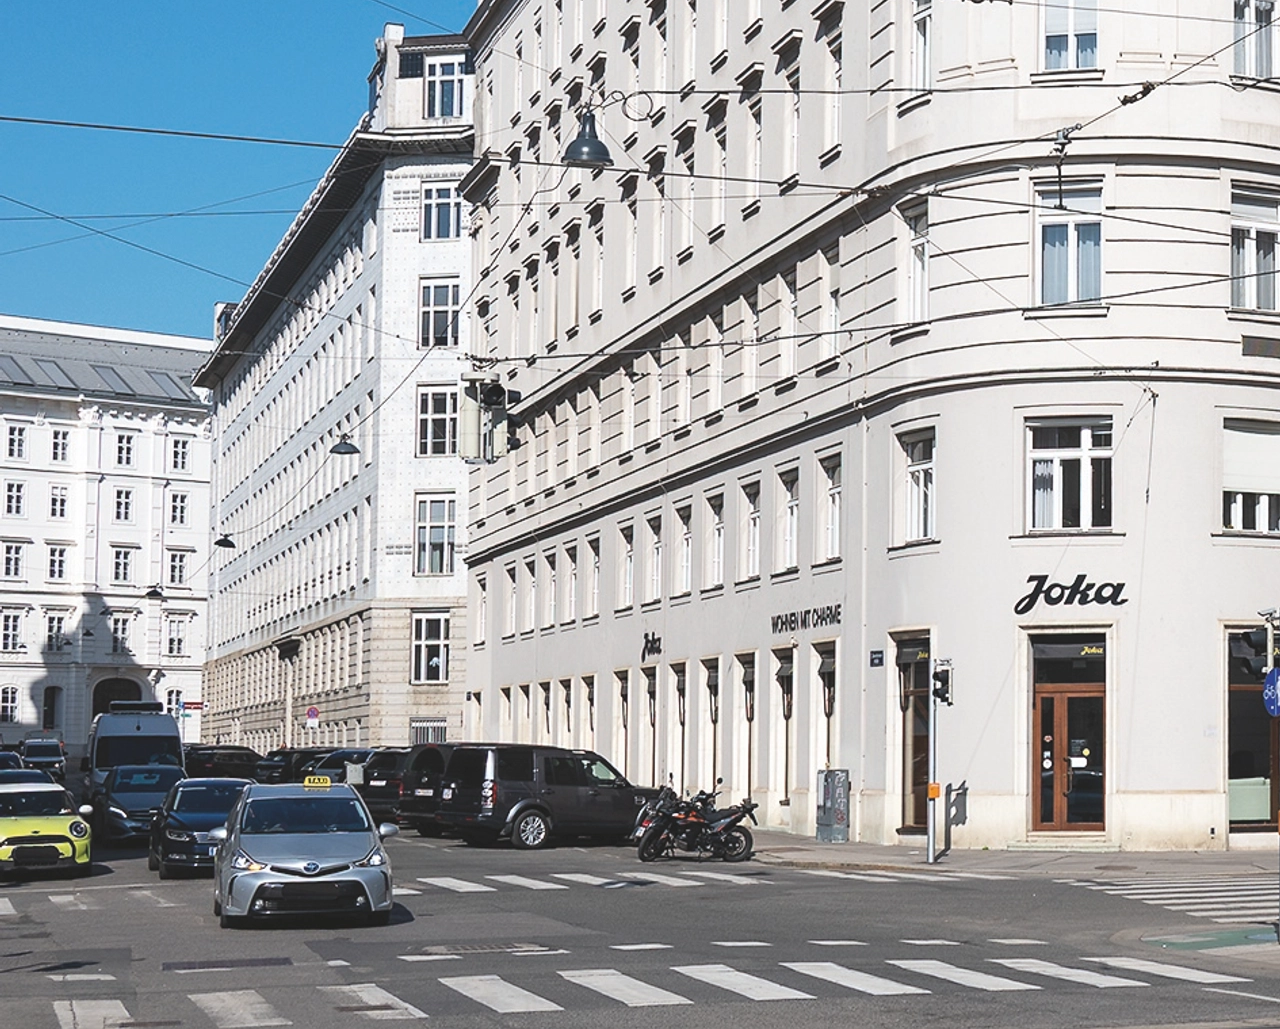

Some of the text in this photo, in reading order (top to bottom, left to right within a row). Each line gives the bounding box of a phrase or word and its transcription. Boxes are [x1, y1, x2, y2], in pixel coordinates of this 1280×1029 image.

[1014, 574, 1129, 615] Joka
[771, 603, 842, 634] WOHNEN MIT CHARME
[641, 632, 663, 664] Joka
[1080, 646, 1104, 656] Joka
